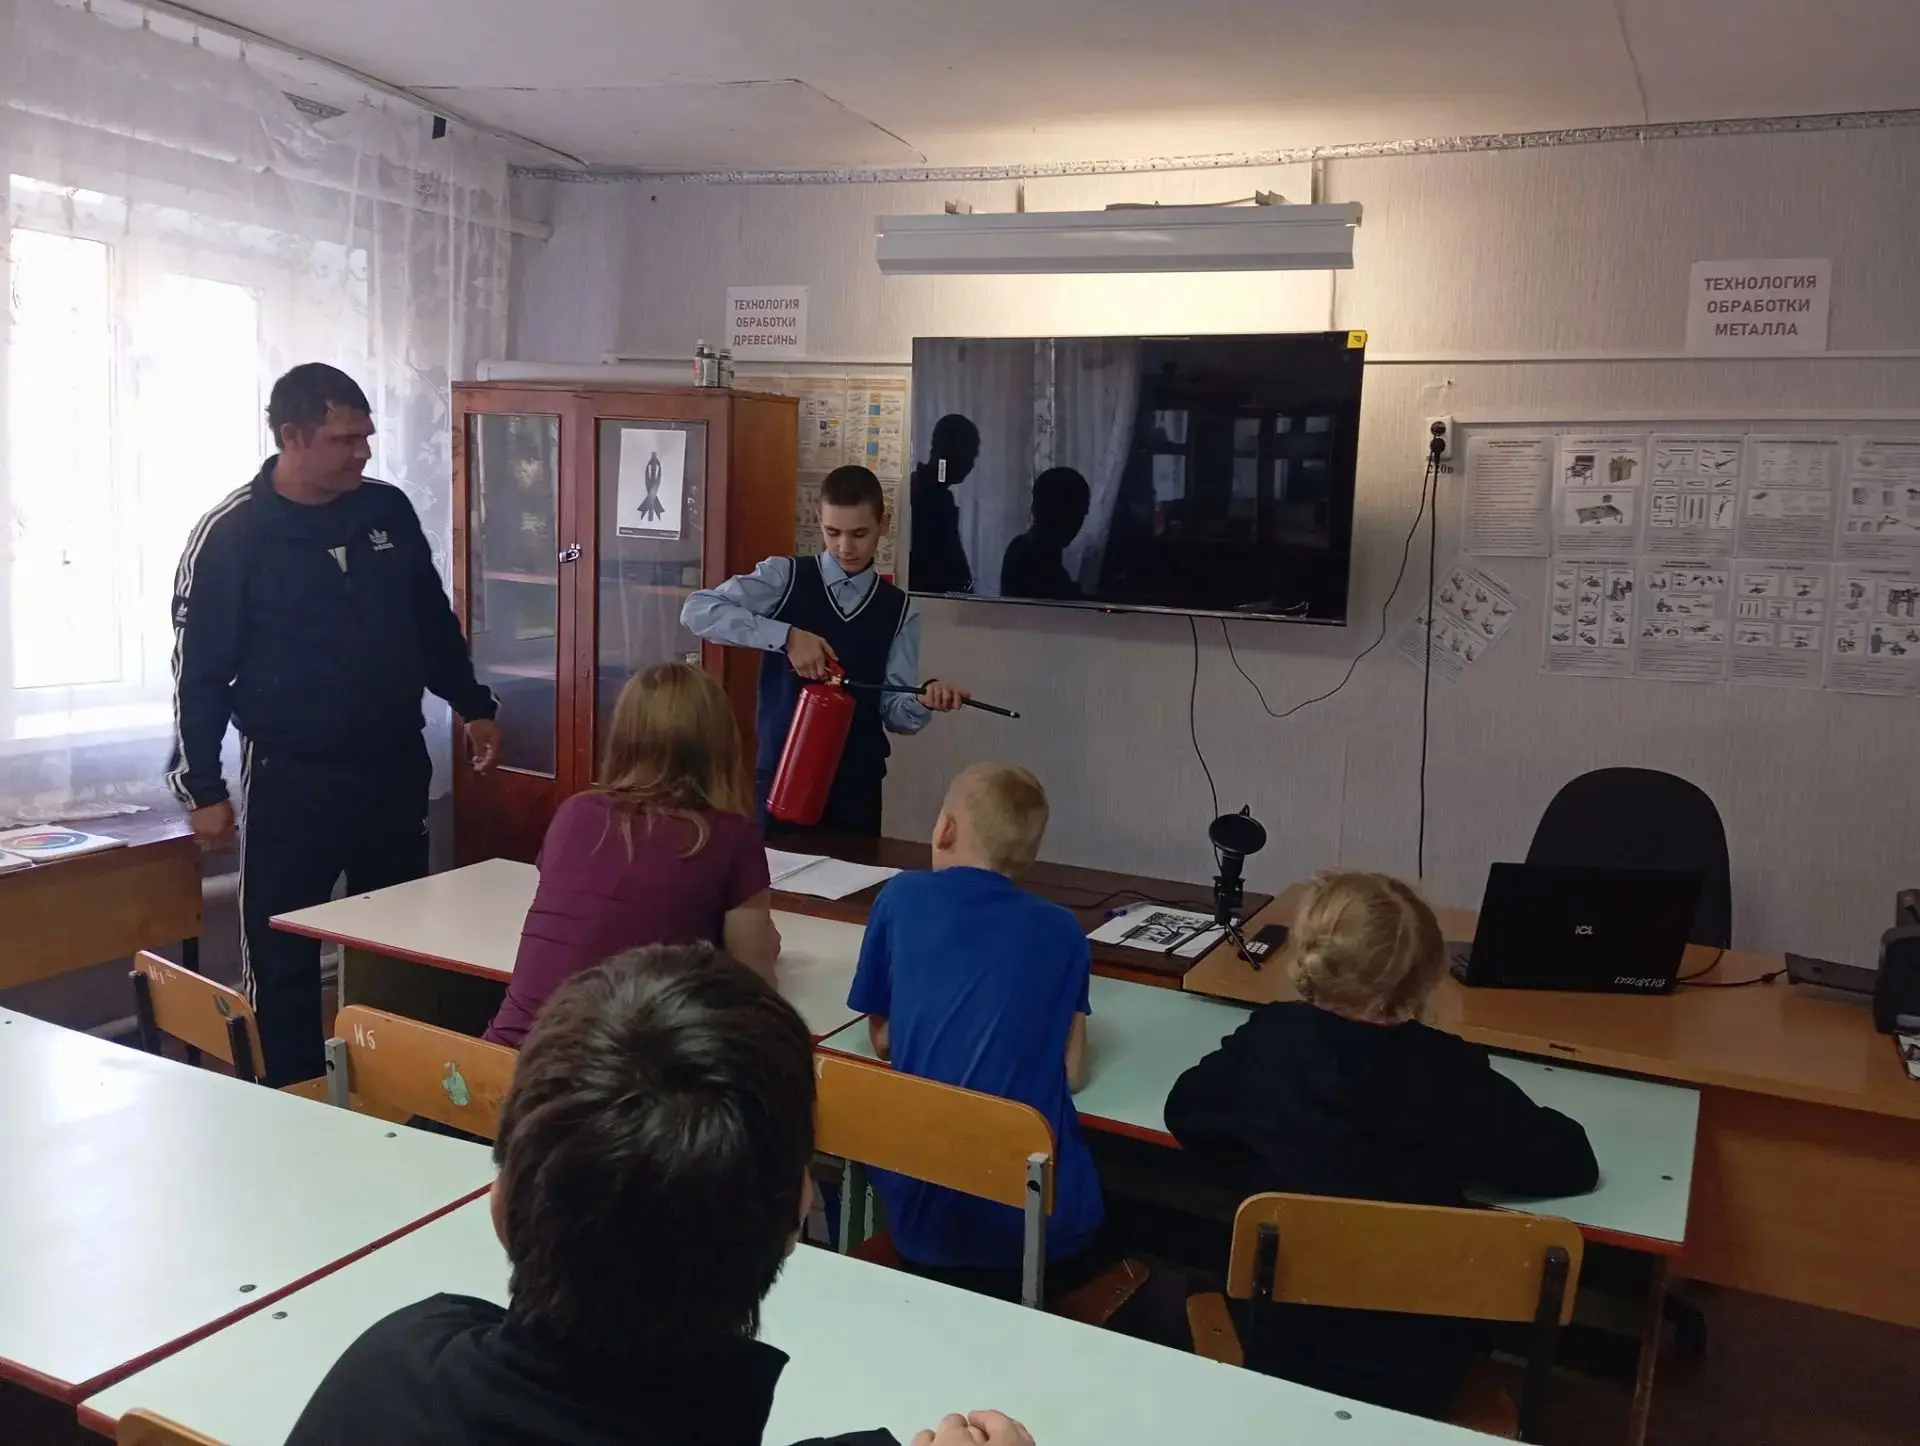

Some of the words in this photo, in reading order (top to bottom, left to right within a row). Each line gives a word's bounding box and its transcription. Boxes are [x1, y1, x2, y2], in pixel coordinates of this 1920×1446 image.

[1704, 275, 1817, 291] ТЕХНОЛОГИЯ
[734, 299, 799, 310] ТЕХНОЛОГИЯ
[1707, 299, 1811, 313] ОБРАБОТКИ
[736, 316, 796, 328] ОБРАБОТКИ
[1715, 322, 1799, 336] МЕТАЛЛА
[733, 334, 797, 346] ДРЕВЕСИНЫ
